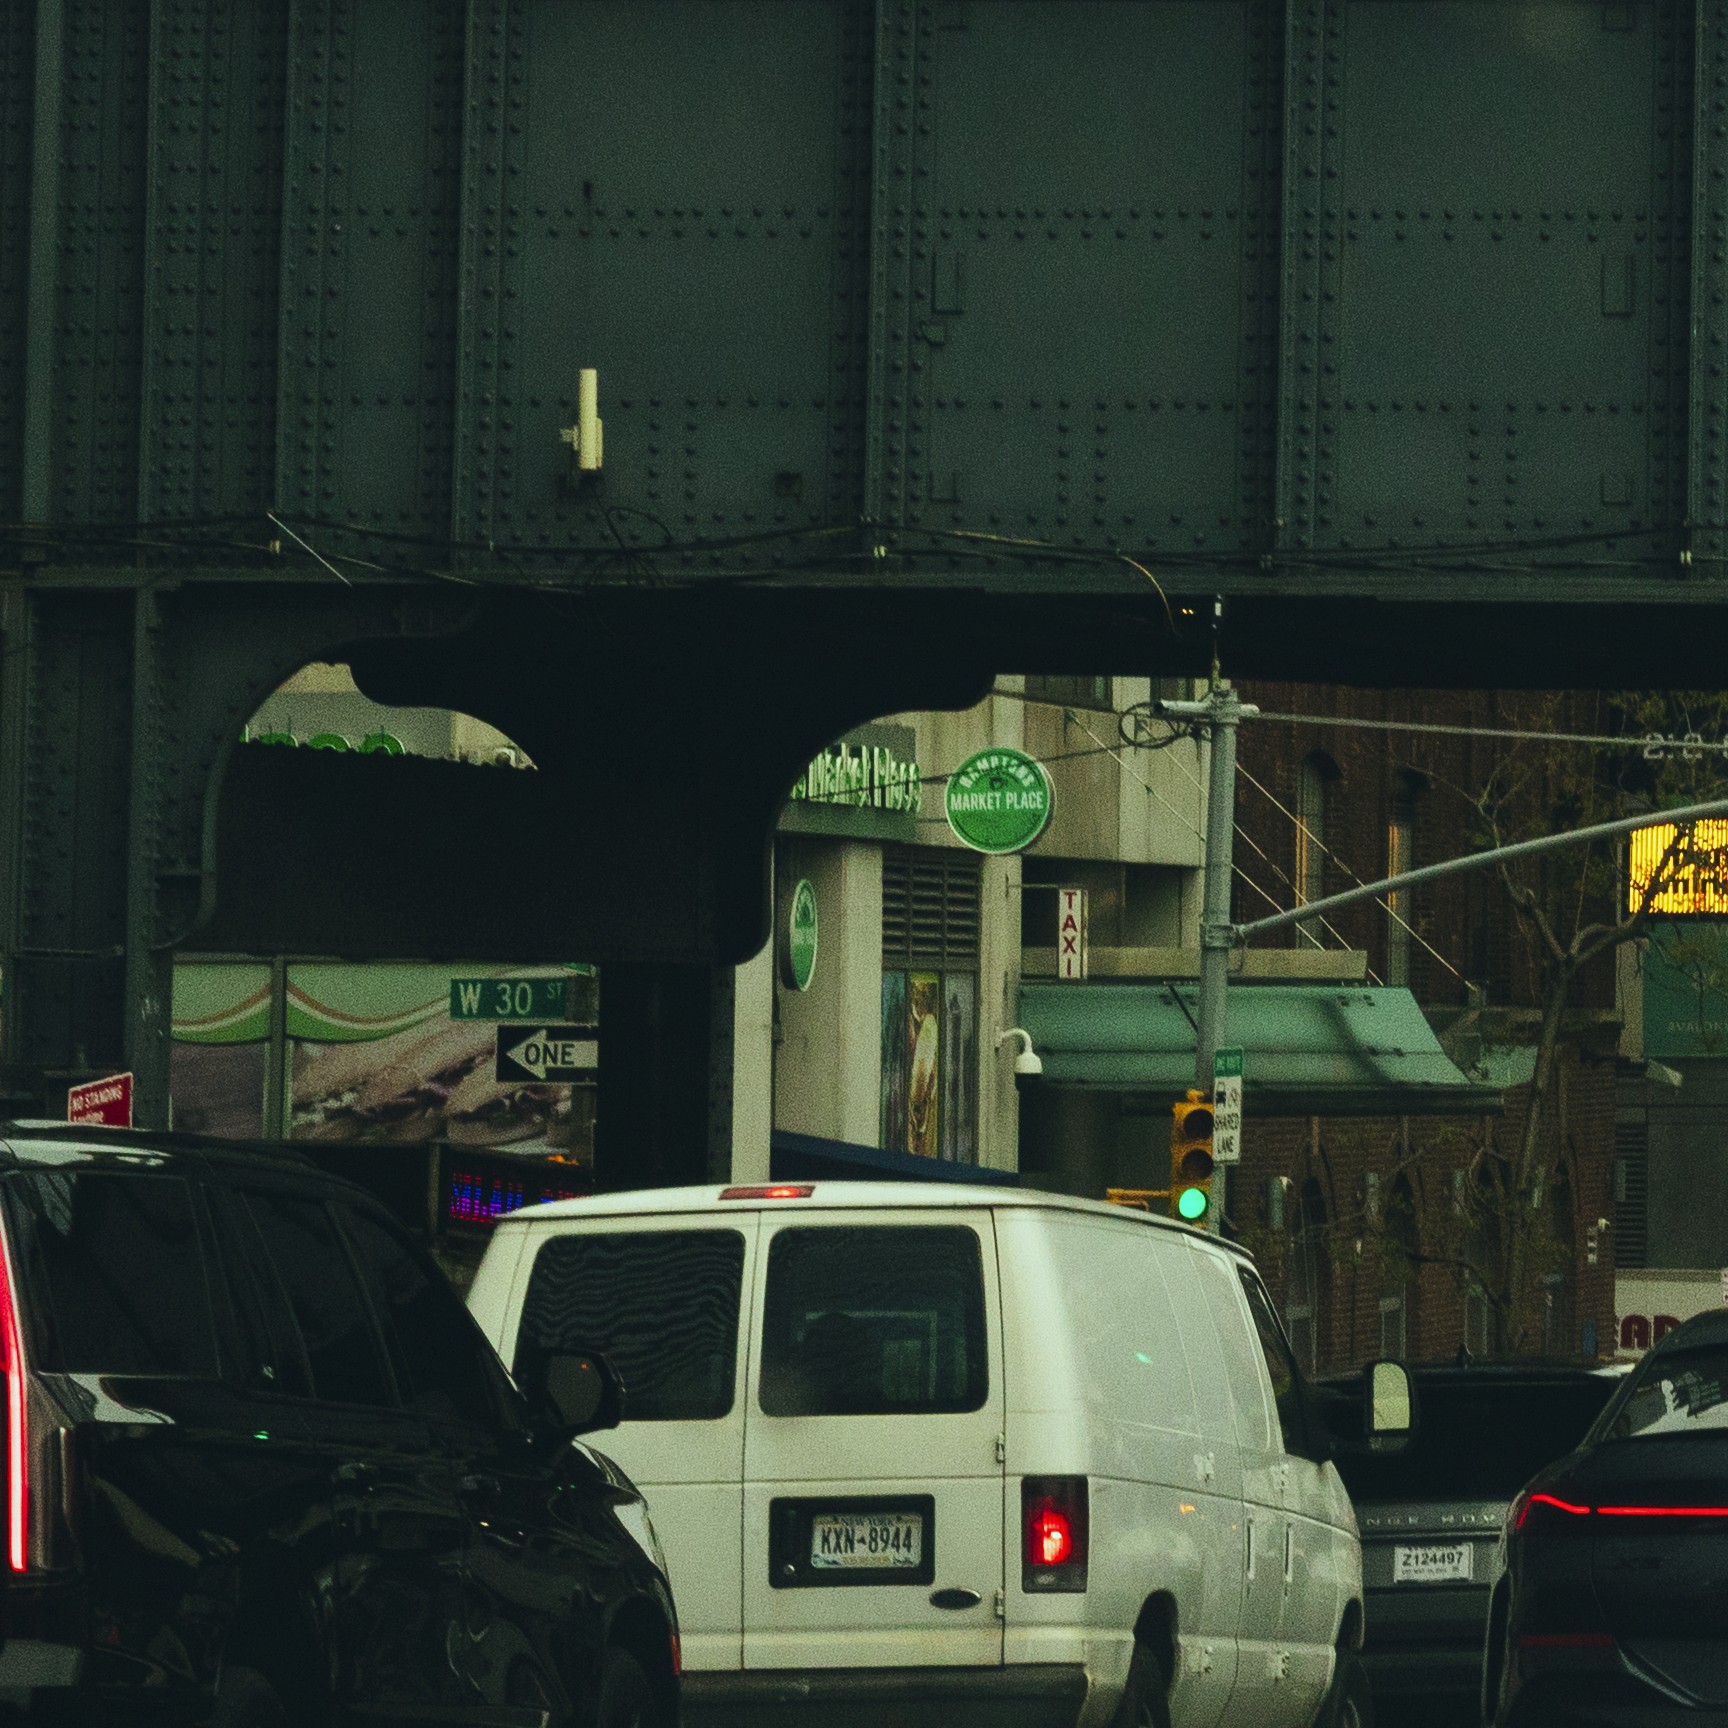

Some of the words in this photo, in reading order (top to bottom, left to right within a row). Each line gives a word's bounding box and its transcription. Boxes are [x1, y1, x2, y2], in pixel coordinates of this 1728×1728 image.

[950, 792, 1001, 811] MARKET
[1006, 791, 1044, 809] PLACE
[1063, 891, 1077, 976] TAXI
[459, 982, 481, 1015] W
[496, 982, 532, 1015] 30
[547, 982, 563, 999] ST
[524, 1043, 575, 1065] ONE
[1403, 1551, 1463, 1567] Z124497
